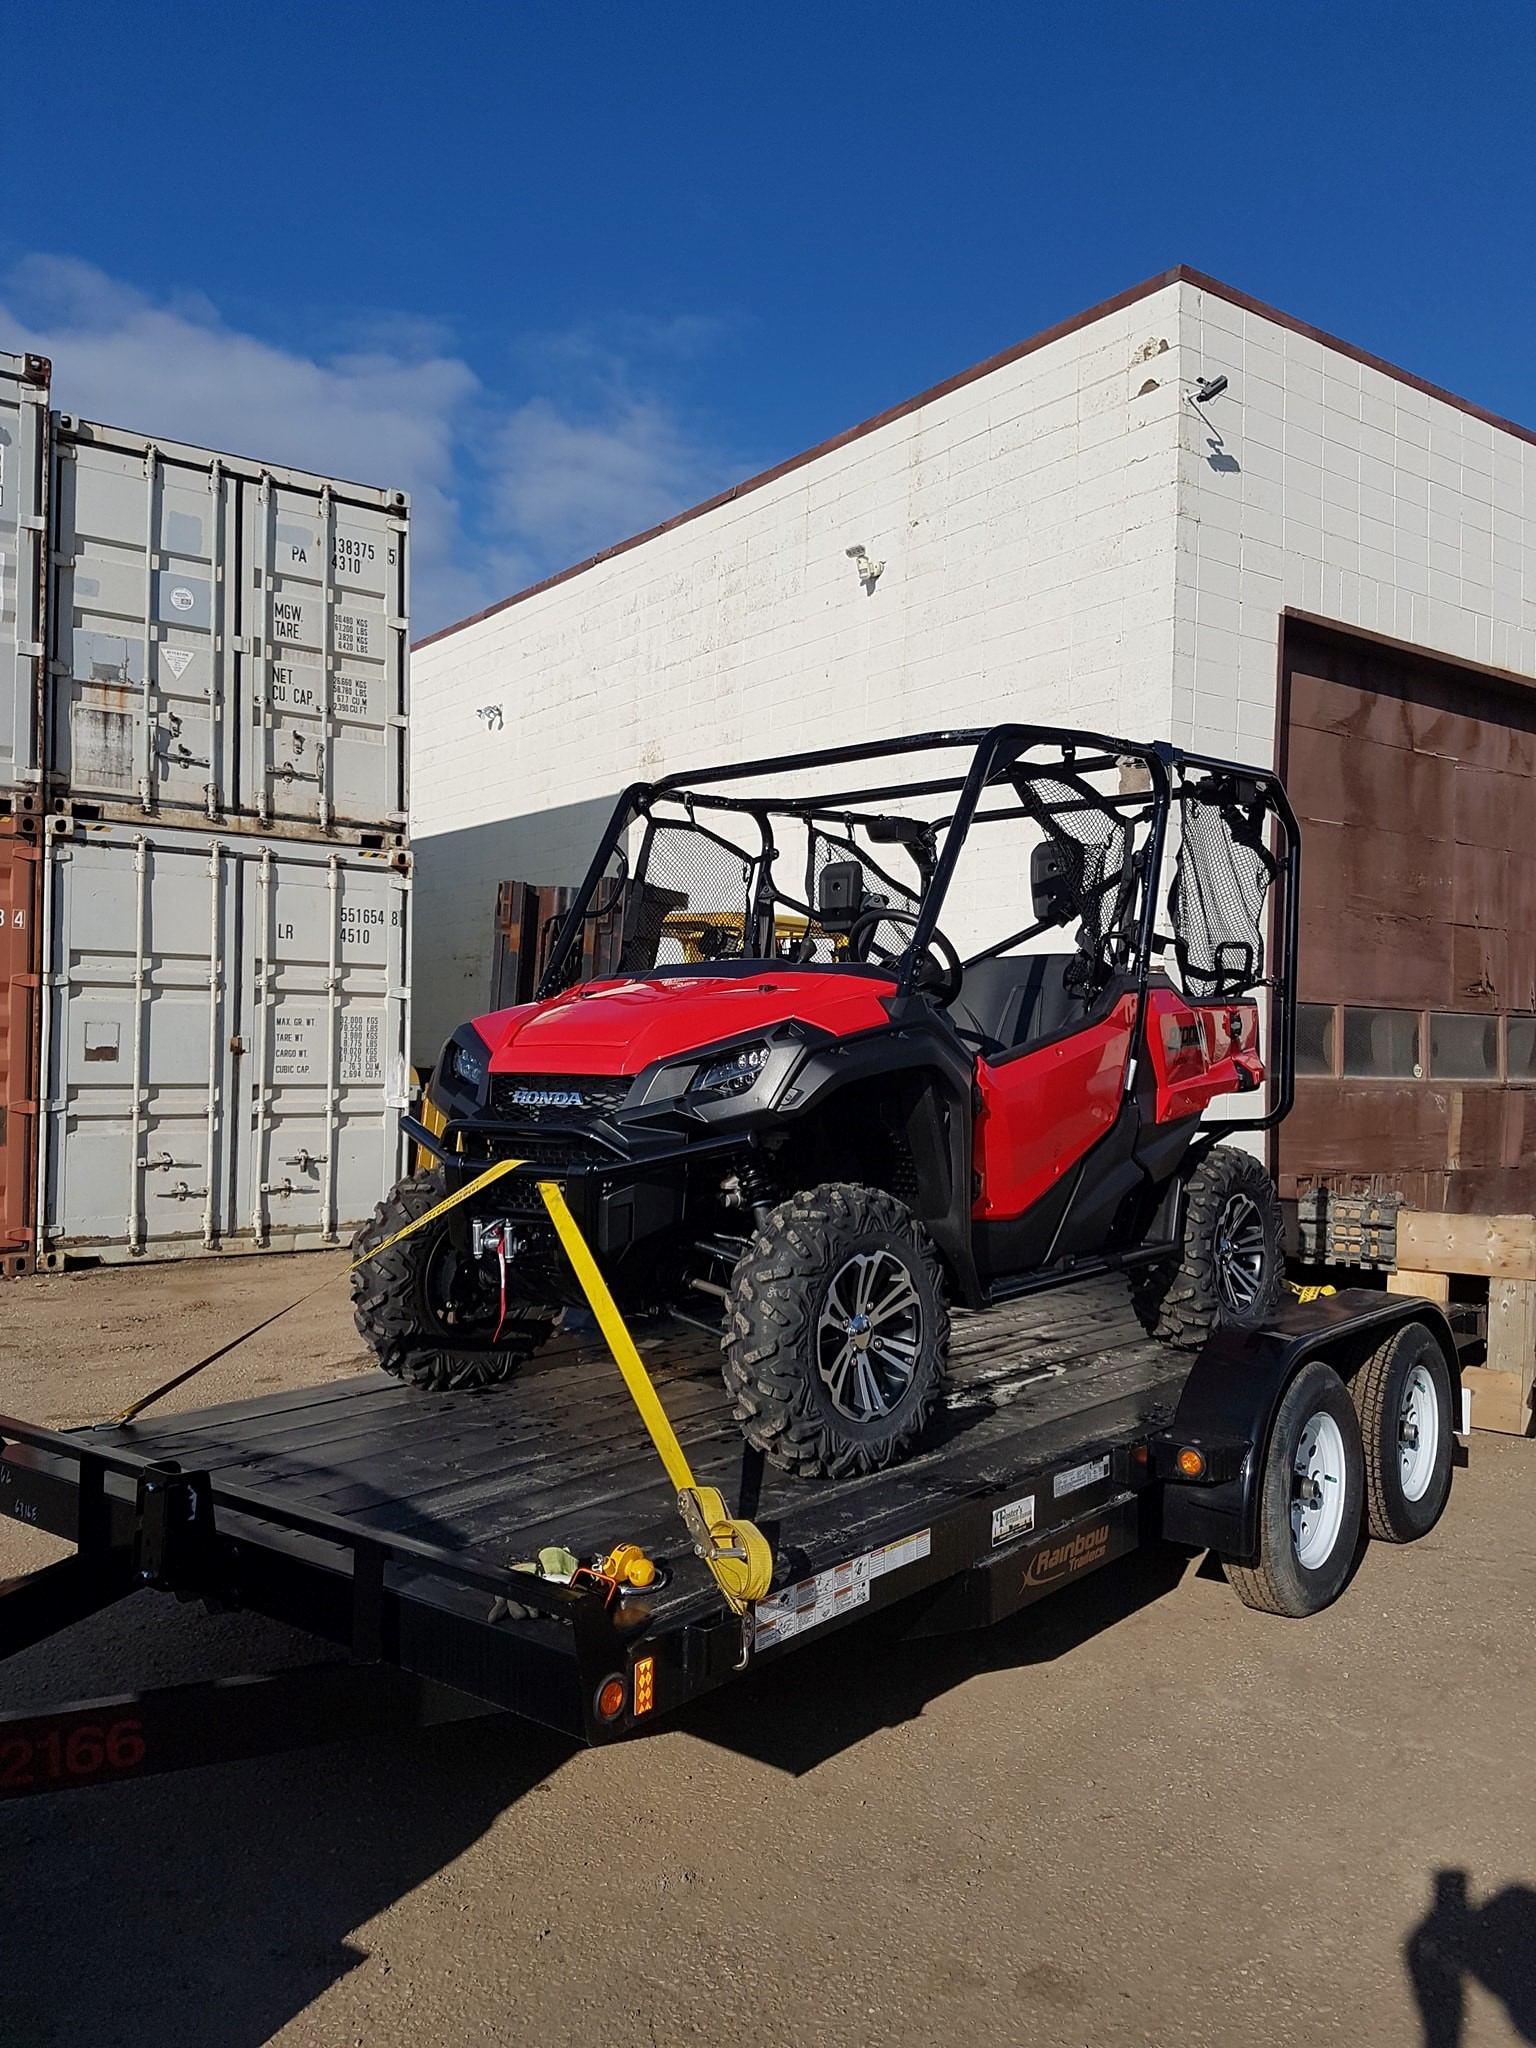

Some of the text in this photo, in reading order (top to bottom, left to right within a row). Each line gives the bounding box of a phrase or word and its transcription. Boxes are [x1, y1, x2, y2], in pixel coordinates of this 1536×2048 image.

[291, 546, 361, 574] PA 4310
[388, 548, 396, 565] 5
[356, 627, 368, 636] LBS
[356, 644, 368, 653] LBS
[14, 911, 23, 927] 4
[340, 907, 398, 926] 551654 8
[278, 923, 370, 944] LR 4510
[366, 1017, 379, 1025] KGS
[366, 1032, 378, 1040] KGS
[366, 1040, 378, 1048] LBS
[275, 1049, 296, 1058] CARGO
[275, 1065, 294, 1073] CUBIC
[512, 1091, 583, 1105] HONDA
[1036, 1525, 1110, 1575] Rainbow
[0, 1719, 145, 1786] 2166
